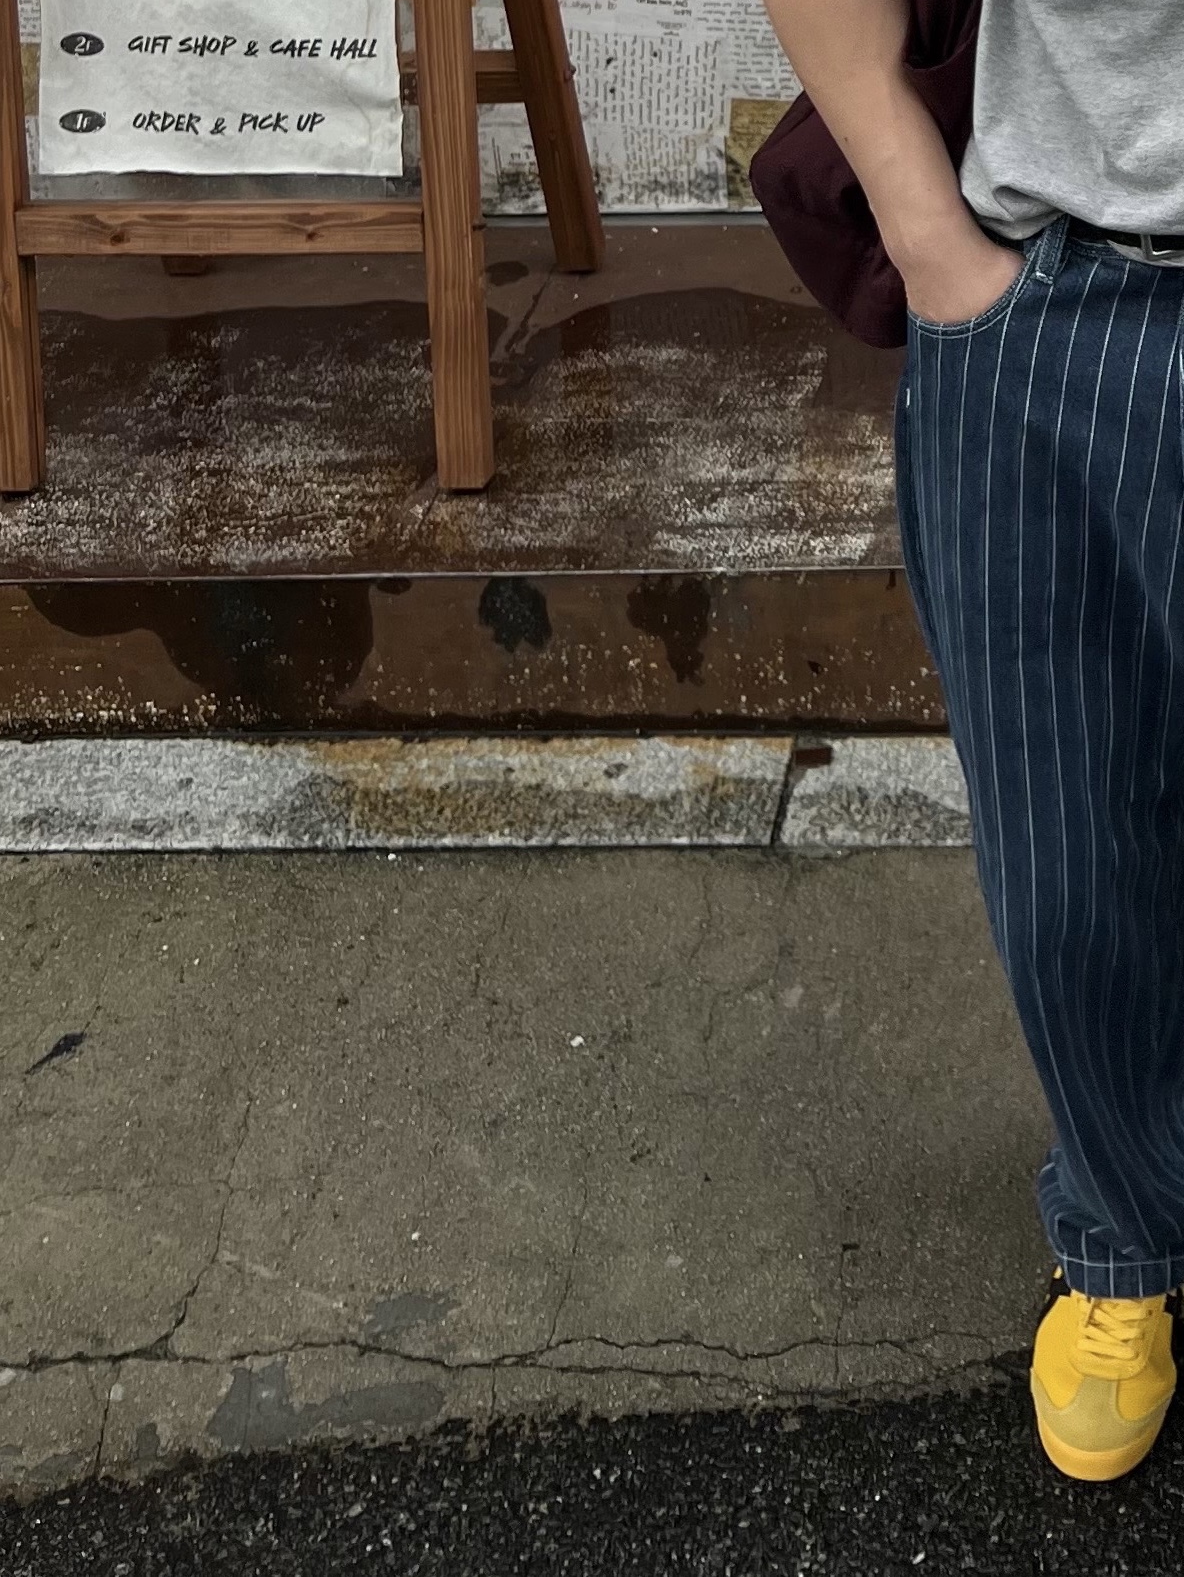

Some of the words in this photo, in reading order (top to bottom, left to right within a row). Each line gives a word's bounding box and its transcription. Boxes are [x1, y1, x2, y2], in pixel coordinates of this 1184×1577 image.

[128, 35, 172, 54] GIFT
[177, 35, 237, 58] SHOP
[243, 38, 260, 57] &
[269, 38, 323, 59] CAFE
[330, 37, 378, 60] HALL
[132, 111, 202, 135] ORDER
[210, 117, 227, 135] &
[238, 111, 289, 133] PICK
[296, 112, 326, 134] UP
